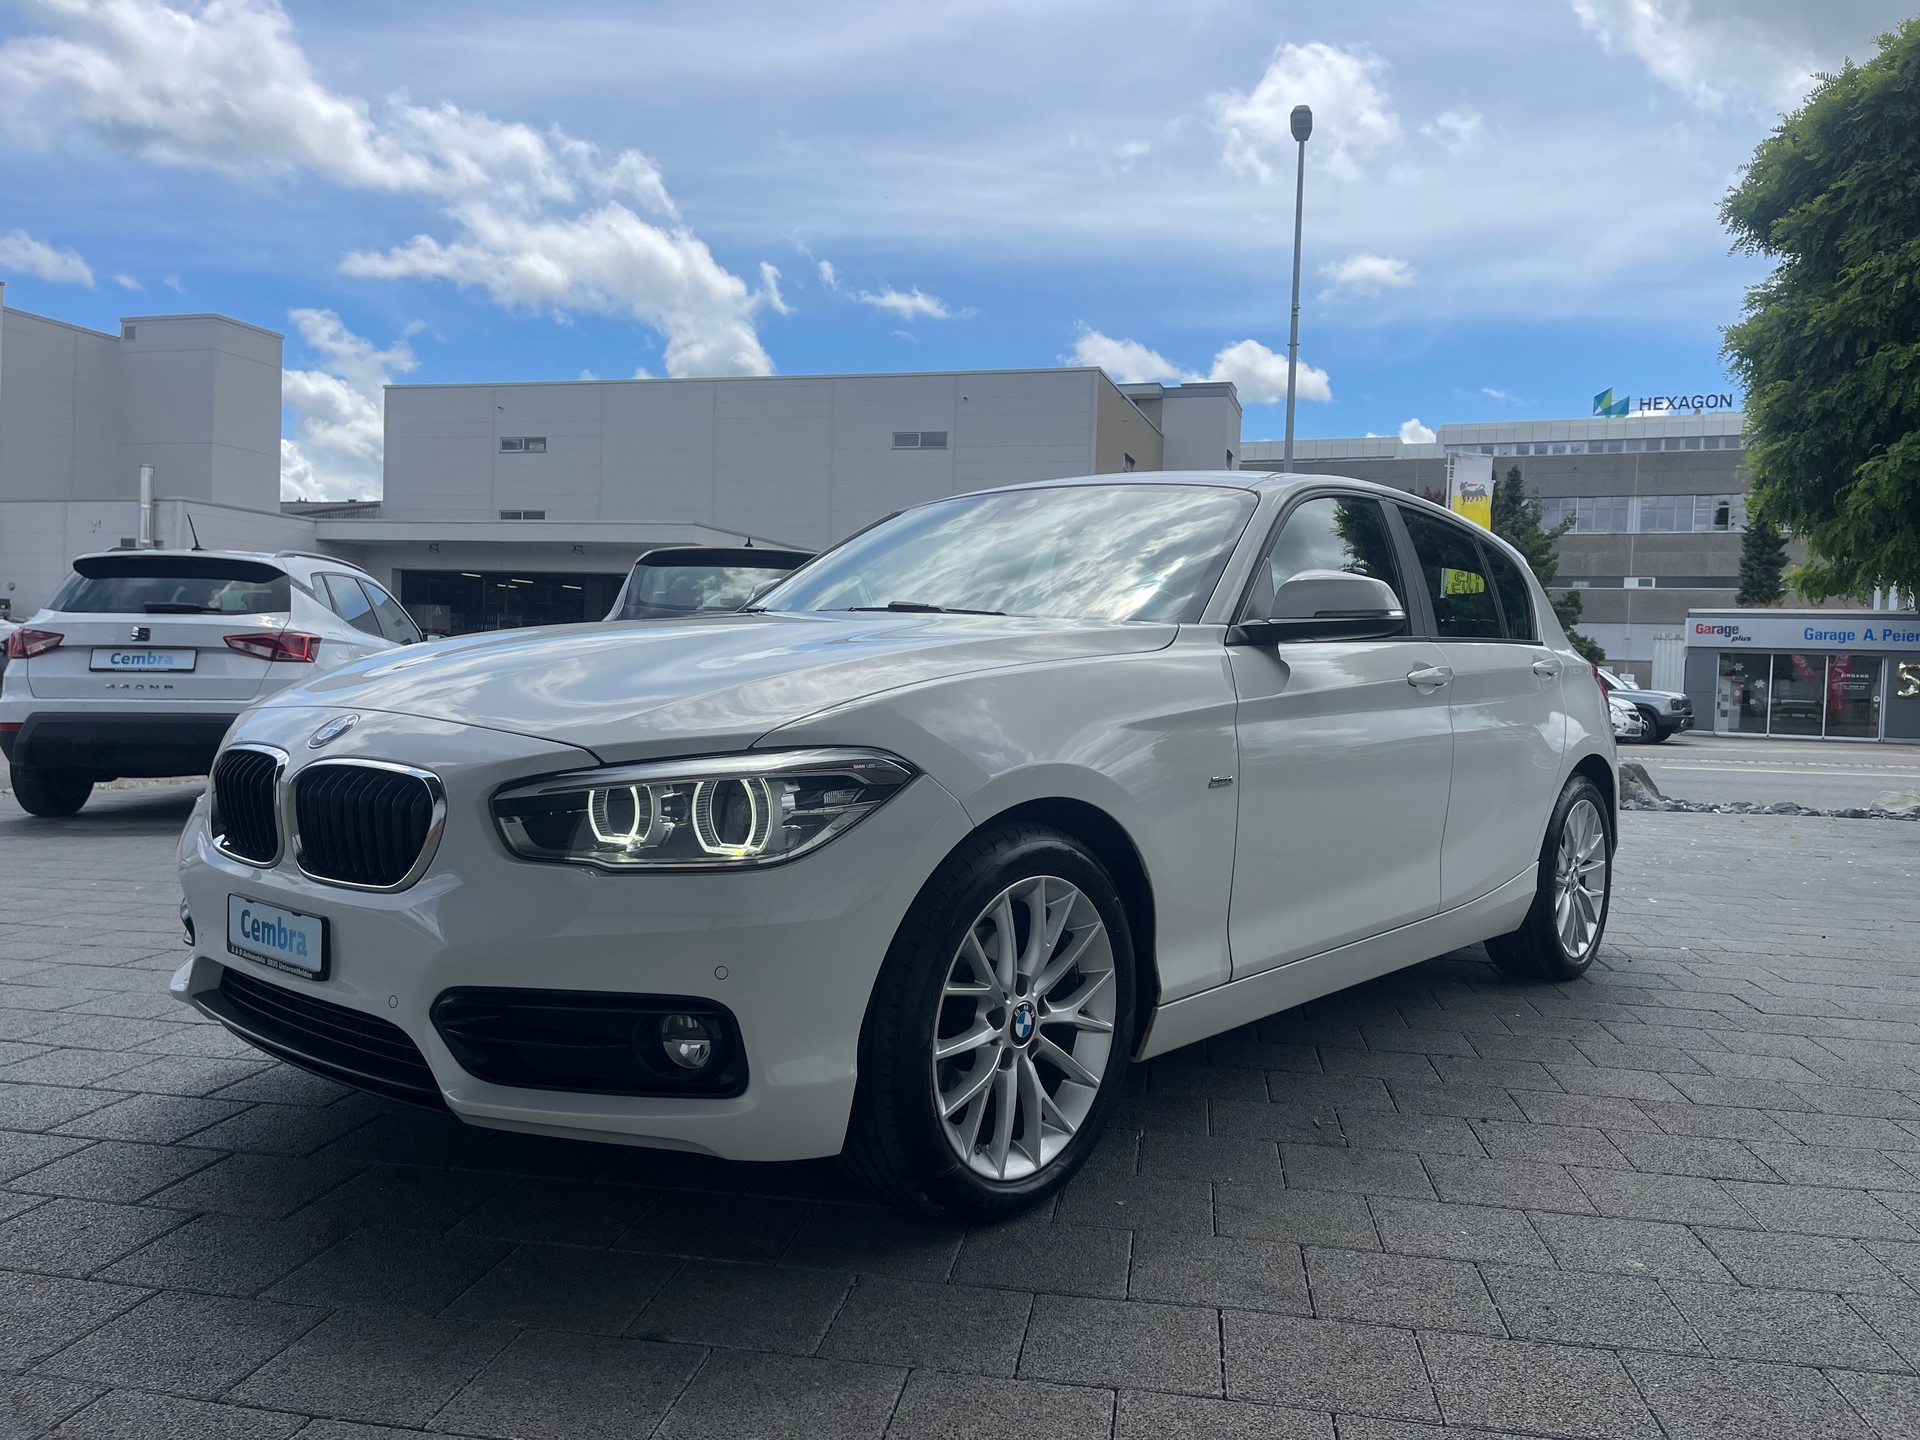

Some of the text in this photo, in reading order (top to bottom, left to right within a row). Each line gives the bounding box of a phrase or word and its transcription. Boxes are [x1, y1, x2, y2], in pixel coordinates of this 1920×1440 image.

[1639, 393, 1733, 411] HEXAGON
[1695, 623, 1739, 638] Garage
[1803, 627, 1856, 644] Garage
[1863, 628, 1878, 641] A.
[1731, 634, 1752, 643] plus
[110, 652, 174, 665] Cembra
[240, 908, 308, 957] Cembra
[1013, 1004, 1036, 1019] BMW
